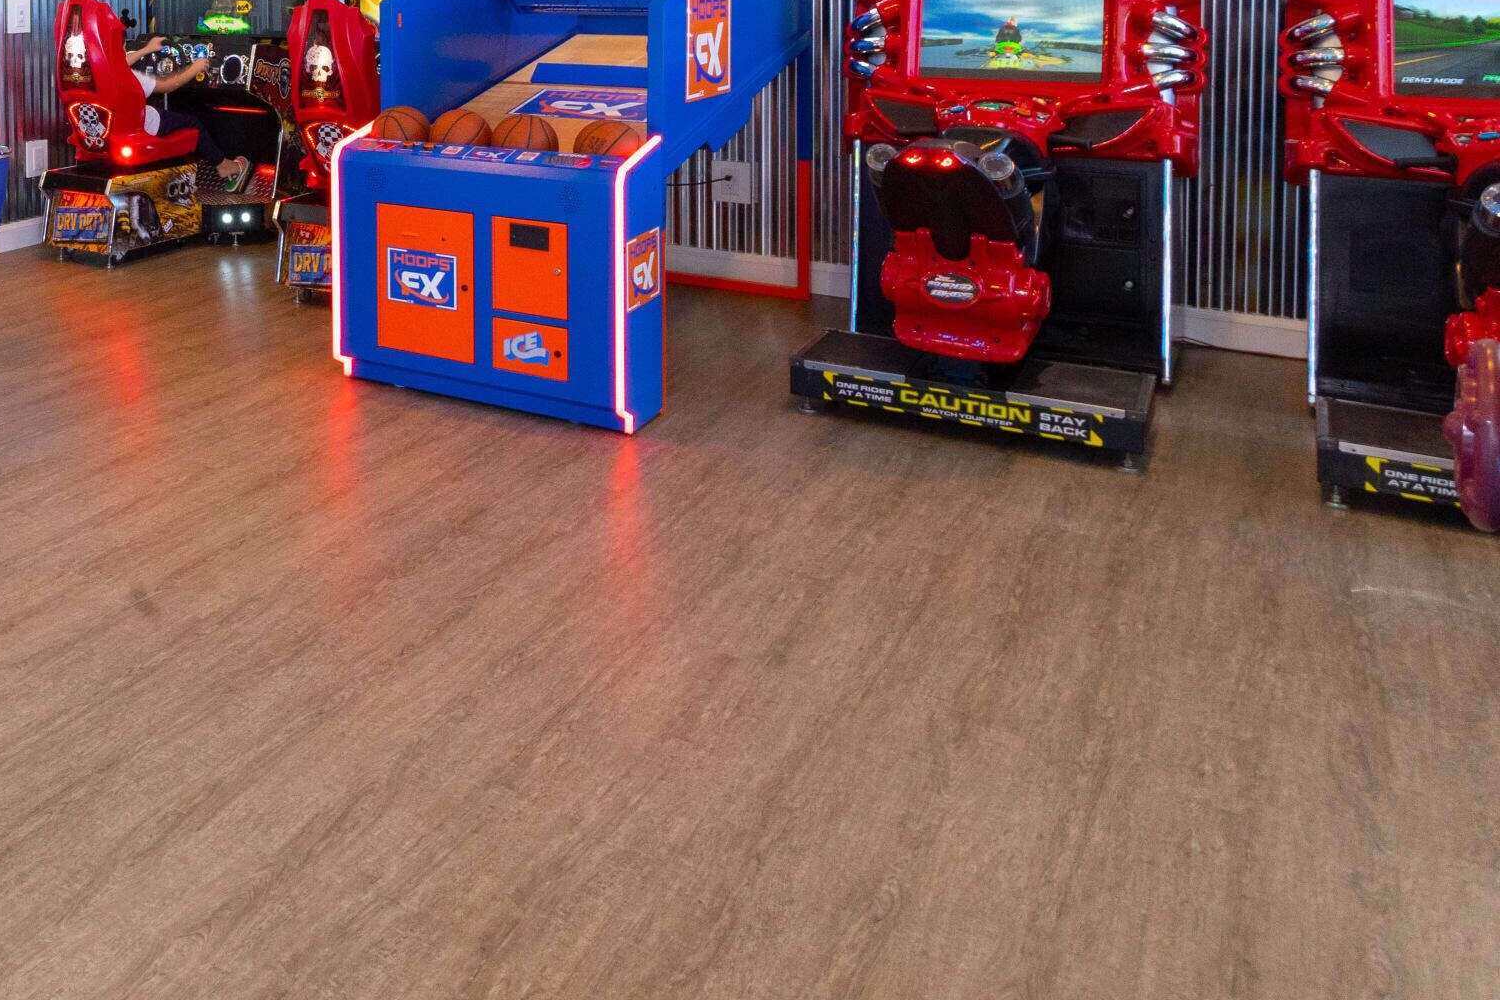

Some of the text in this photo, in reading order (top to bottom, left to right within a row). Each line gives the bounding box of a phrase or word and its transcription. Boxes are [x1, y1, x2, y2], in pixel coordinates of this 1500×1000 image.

[1401, 76, 1465, 85] DEMO MODE
[57, 213, 76, 231] DRV
[393, 253, 451, 271] HOOPS
[503, 331, 550, 367] ICE
[836, 381, 894, 396] ONE RIDER
[839, 388, 853, 397] AT
[865, 393, 892, 403] TIME
[900, 389, 1031, 424] CAUTION
[922, 406, 958, 418] WATCH
[959, 412, 987, 422] YOUR
[1040, 412, 1086, 427] STAY
[1040, 422, 1088, 438] BACK
[1385, 469, 1456, 488] ONE RIDE
[1388, 479, 1410, 489] AT
[1427, 485, 1459, 498] TIM
